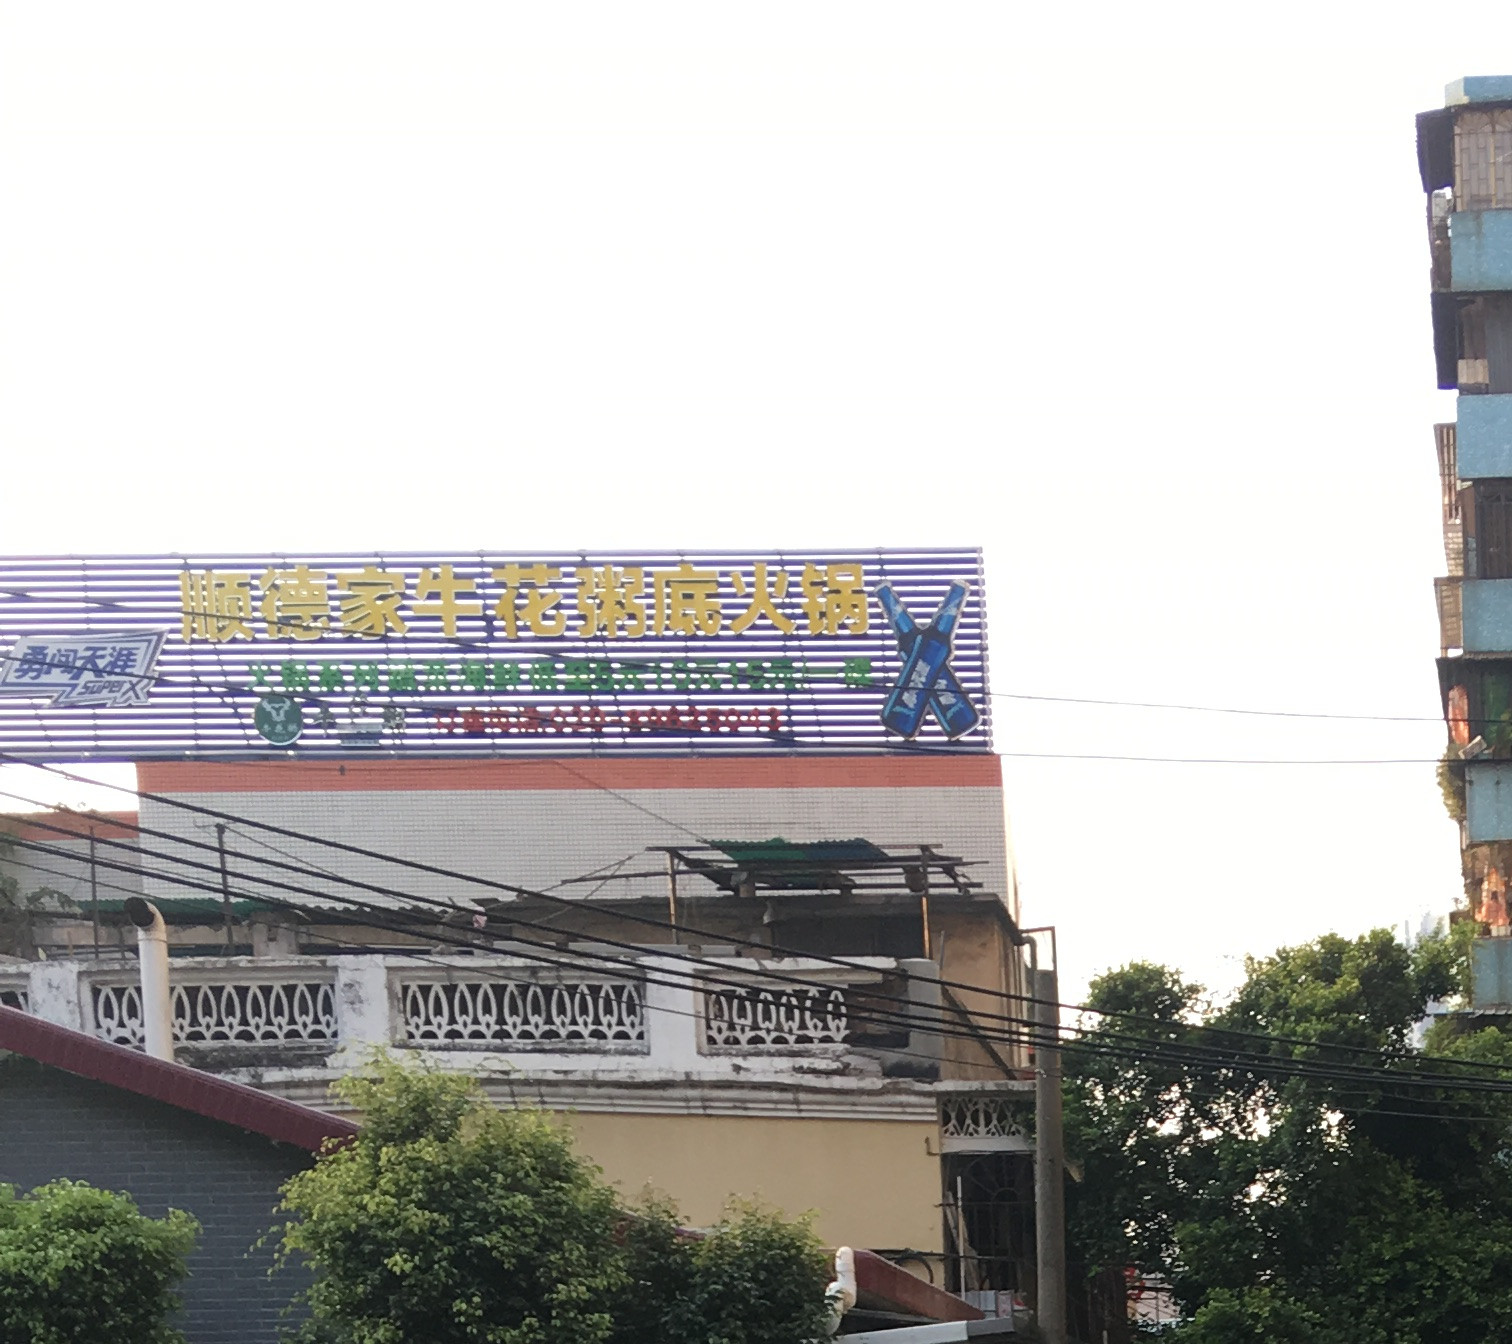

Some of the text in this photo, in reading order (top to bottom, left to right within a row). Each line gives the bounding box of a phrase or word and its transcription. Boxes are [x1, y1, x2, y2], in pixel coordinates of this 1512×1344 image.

[179, 563, 869, 643] 顺德家牛花粥底火锅
[14, 645, 138, 681] 勇闯天涯
